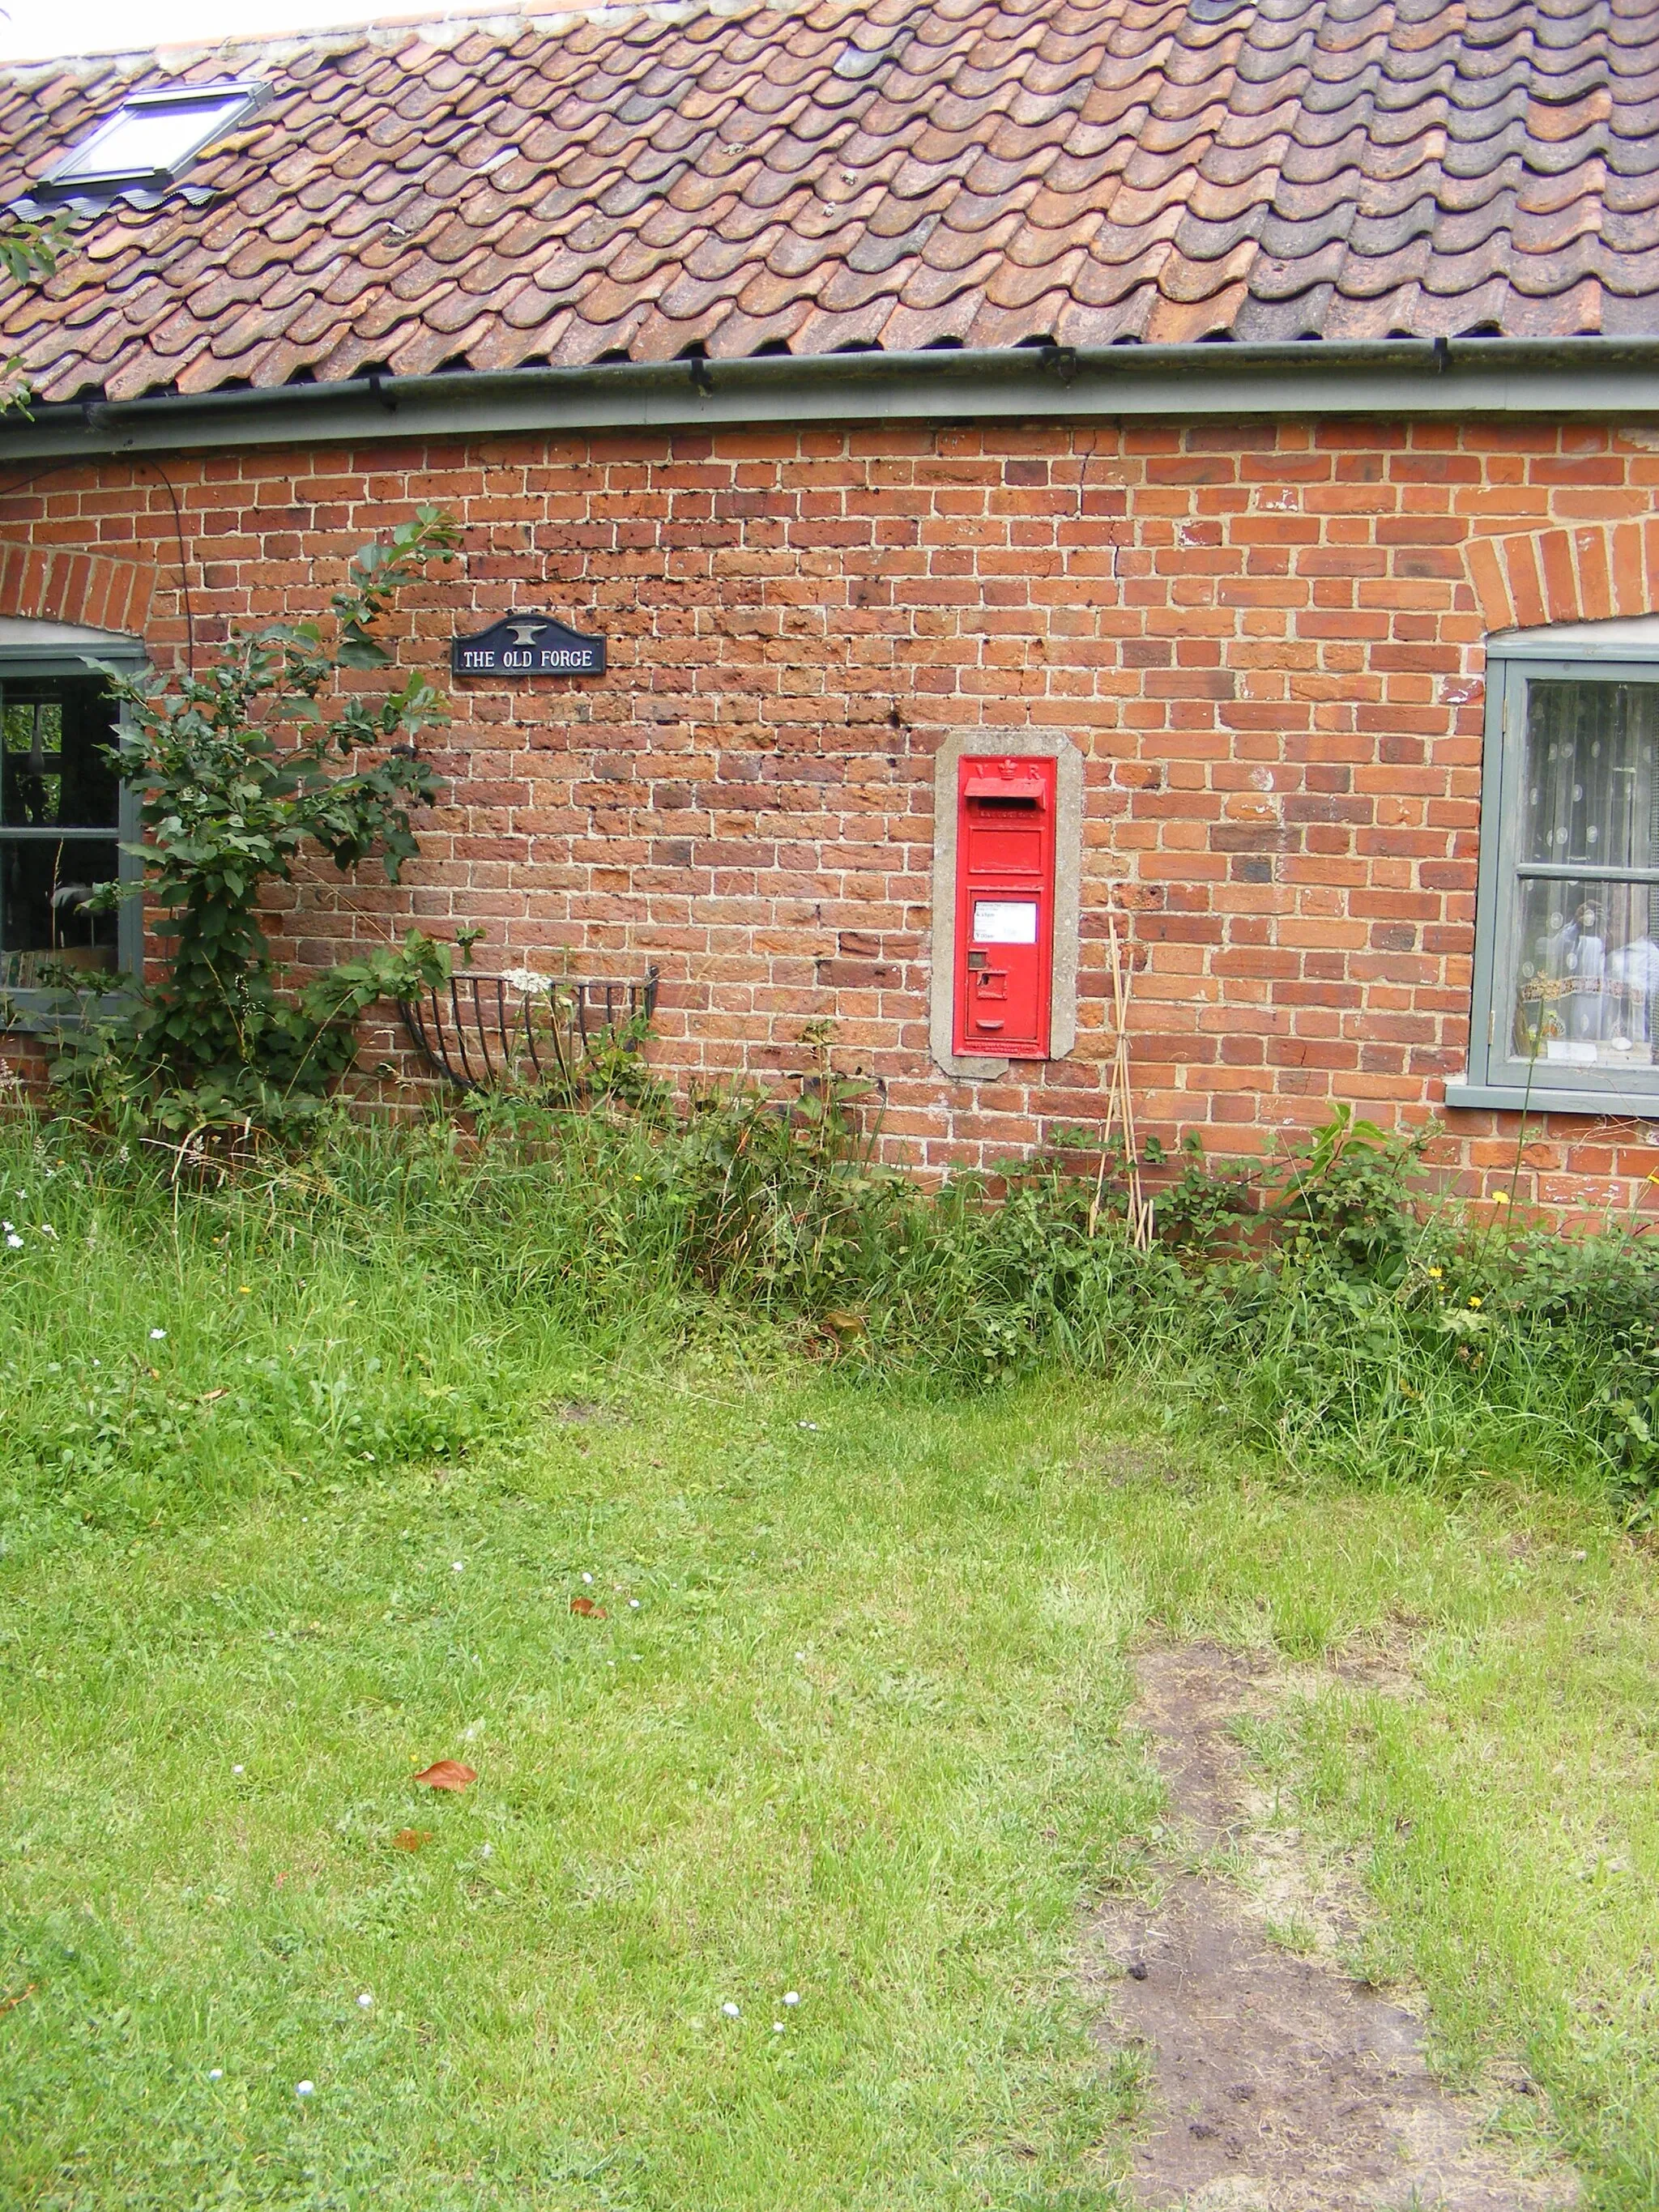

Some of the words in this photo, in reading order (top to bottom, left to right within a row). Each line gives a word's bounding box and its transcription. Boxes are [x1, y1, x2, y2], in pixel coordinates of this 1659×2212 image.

[464, 651, 495, 667] THE
[503, 651, 532, 667] OLD
[541, 650, 592, 667] FORGE
[1026, 763, 1041, 780] R
